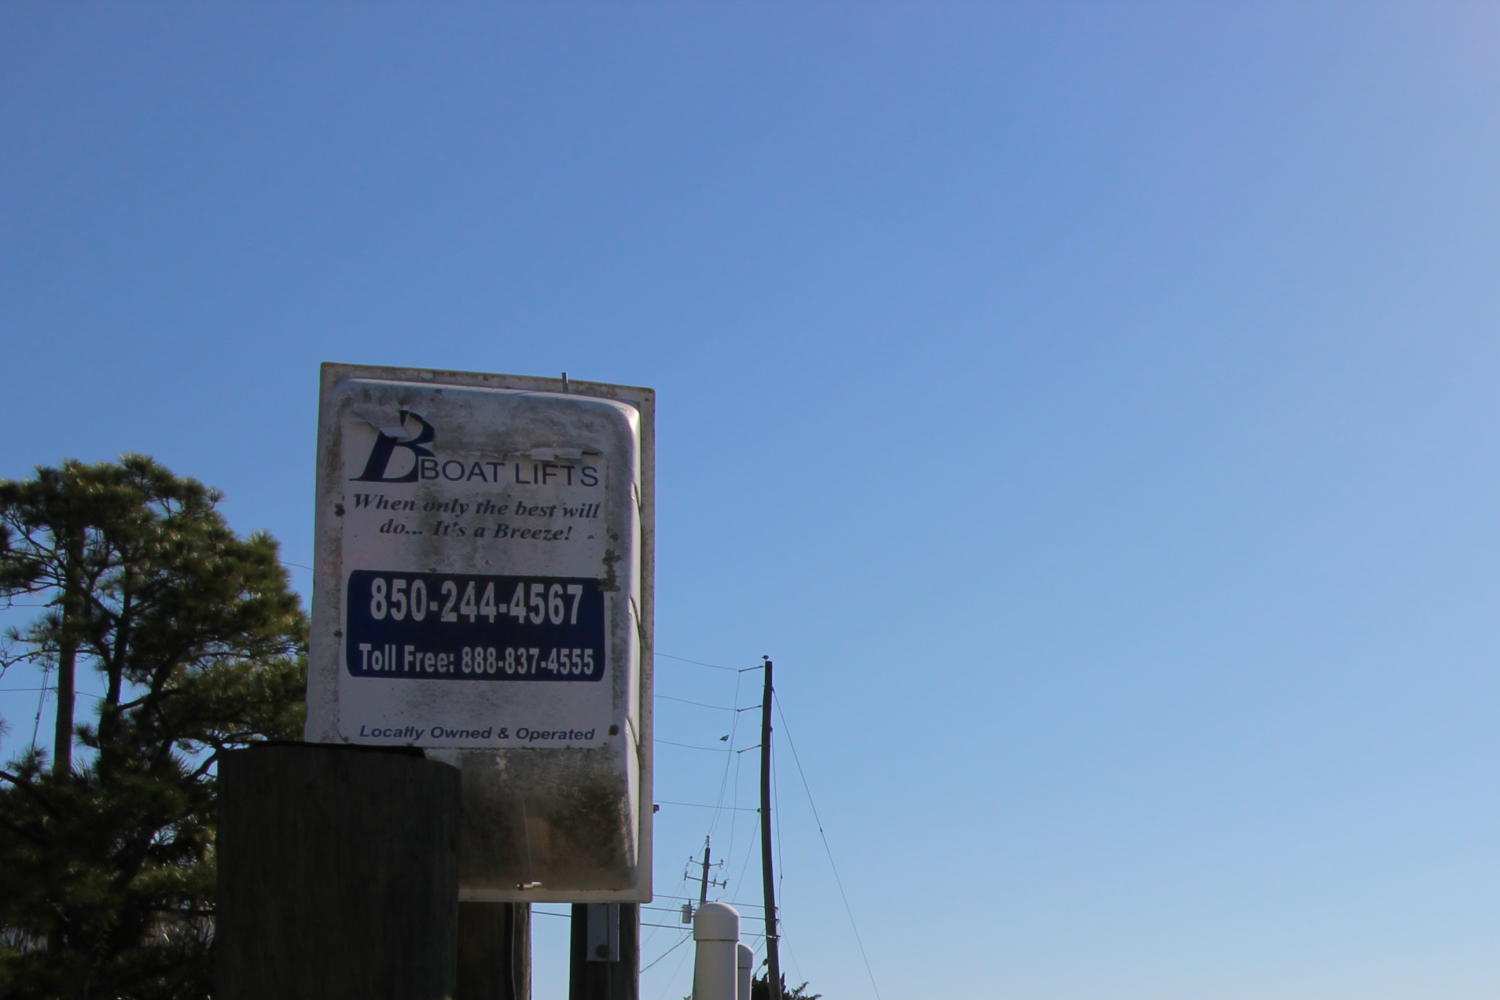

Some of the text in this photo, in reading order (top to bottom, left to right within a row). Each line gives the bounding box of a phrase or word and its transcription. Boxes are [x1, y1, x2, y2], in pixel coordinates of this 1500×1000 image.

[419, 458, 599, 487] BOAT LIFTS
[353, 494, 600, 519] When only the best will
[379, 518, 573, 542] do... It's a Breeze!
[370, 577, 584, 625] 850-244-4567
[358, 643, 595, 676] Toll Free: 888-837-4555
[359, 725, 596, 742] Locally Owned & Operated
